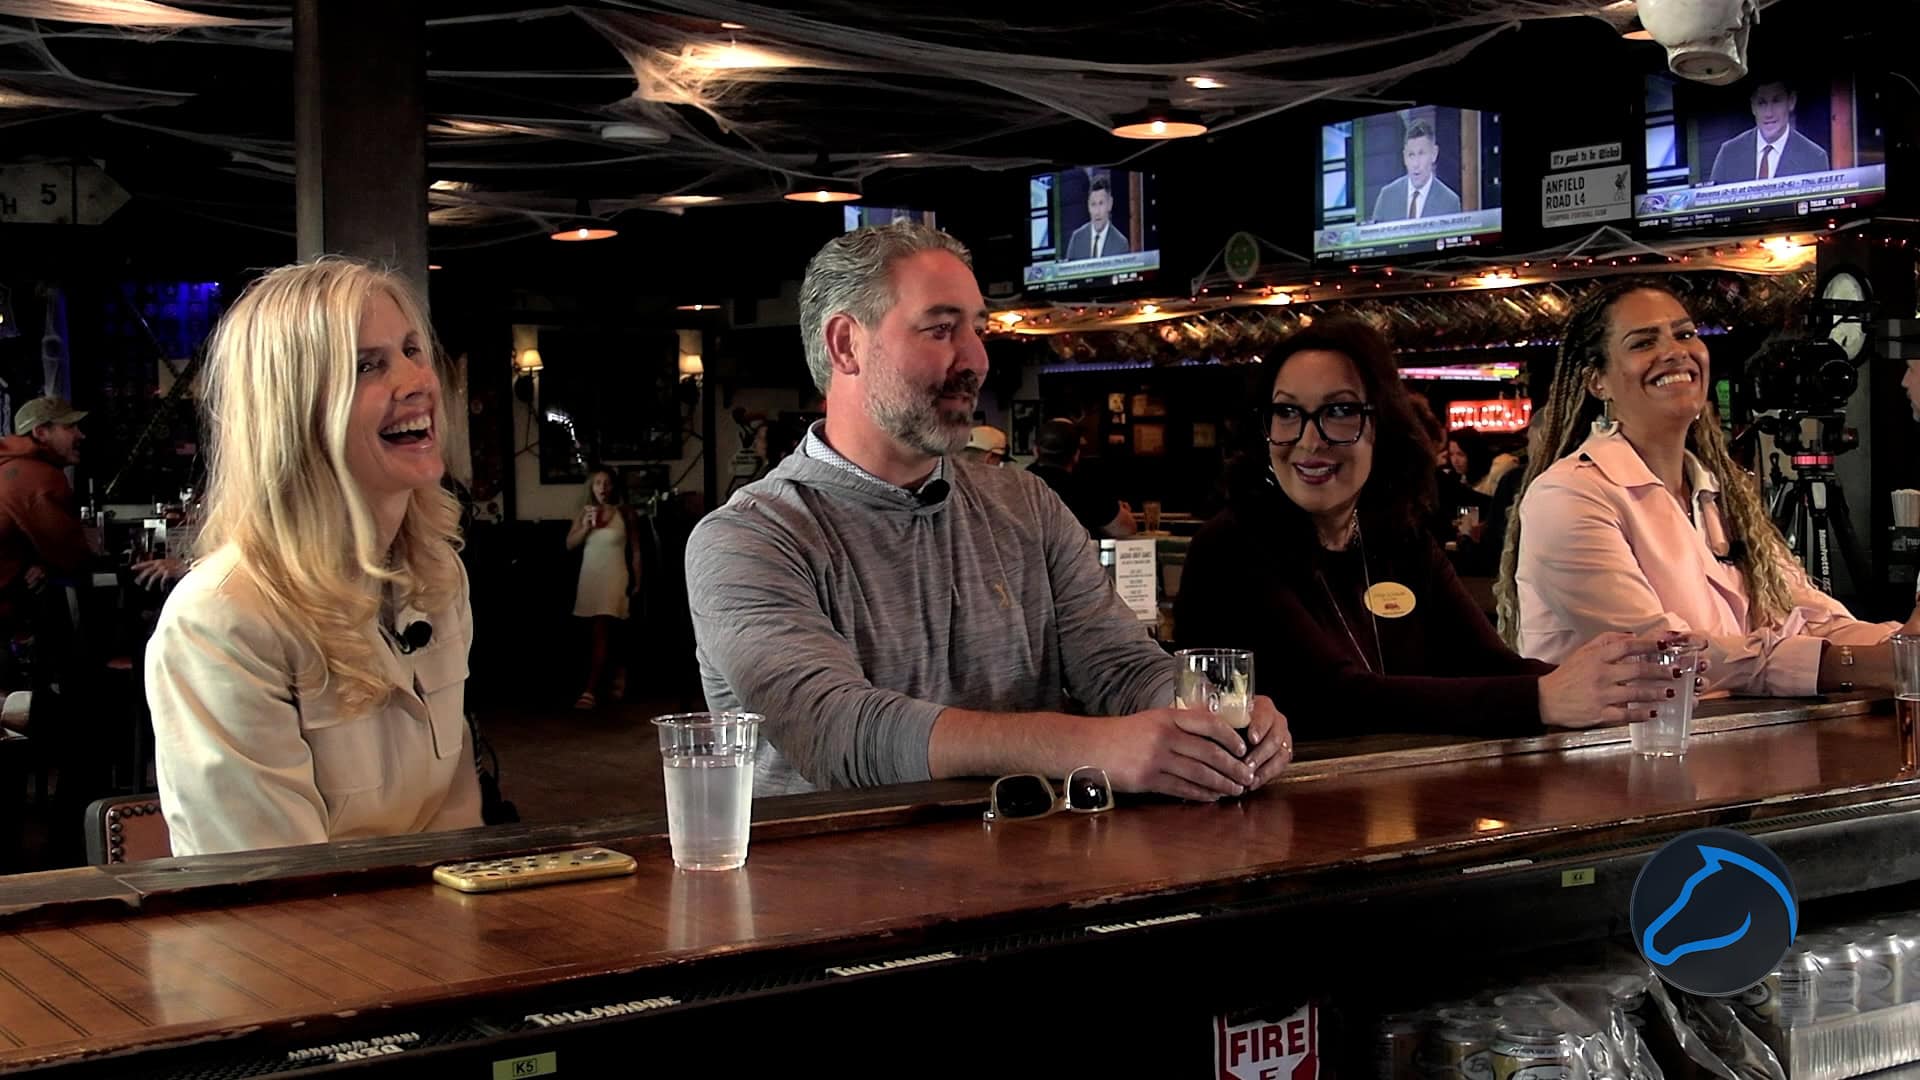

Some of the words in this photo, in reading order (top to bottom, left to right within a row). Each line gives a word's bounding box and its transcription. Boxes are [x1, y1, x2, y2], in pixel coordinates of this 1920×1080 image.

[41, 183, 57, 205] 5
[1546, 176, 1585, 194] ANFIELD
[1546, 194, 1571, 210] ROAD
[1575, 192, 1586, 206] L4
[1818, 529, 1829, 576] Manfrotto
[524, 996, 681, 1027] TULLAMORE
[1230, 1019, 1305, 1067] FIRE
[516, 1061, 534, 1074] K5
